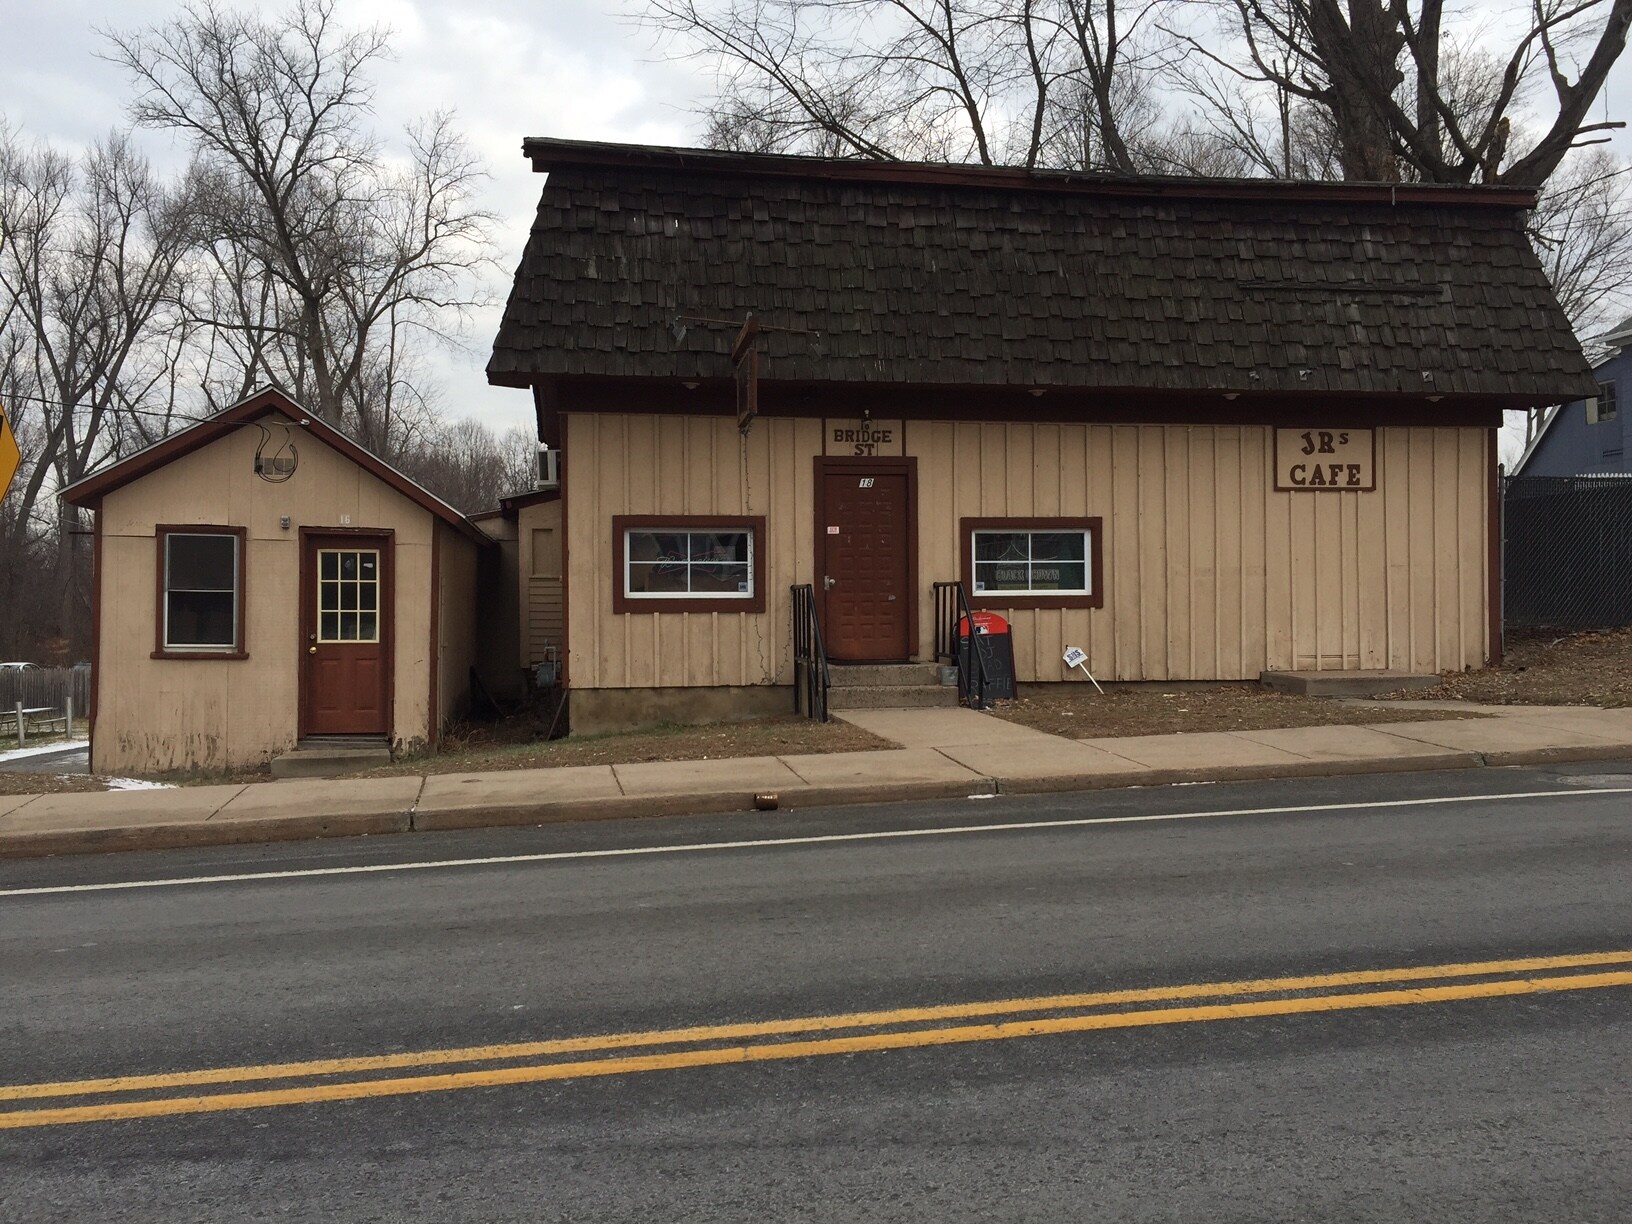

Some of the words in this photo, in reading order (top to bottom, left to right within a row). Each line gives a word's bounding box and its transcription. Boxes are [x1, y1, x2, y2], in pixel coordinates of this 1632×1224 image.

[834, 429, 892, 443] BRIDGE
[854, 443, 875, 456] ST
[1289, 463, 1361, 486] CAFE
[861, 479, 872, 487] 18
[340, 514, 351, 524] 16
